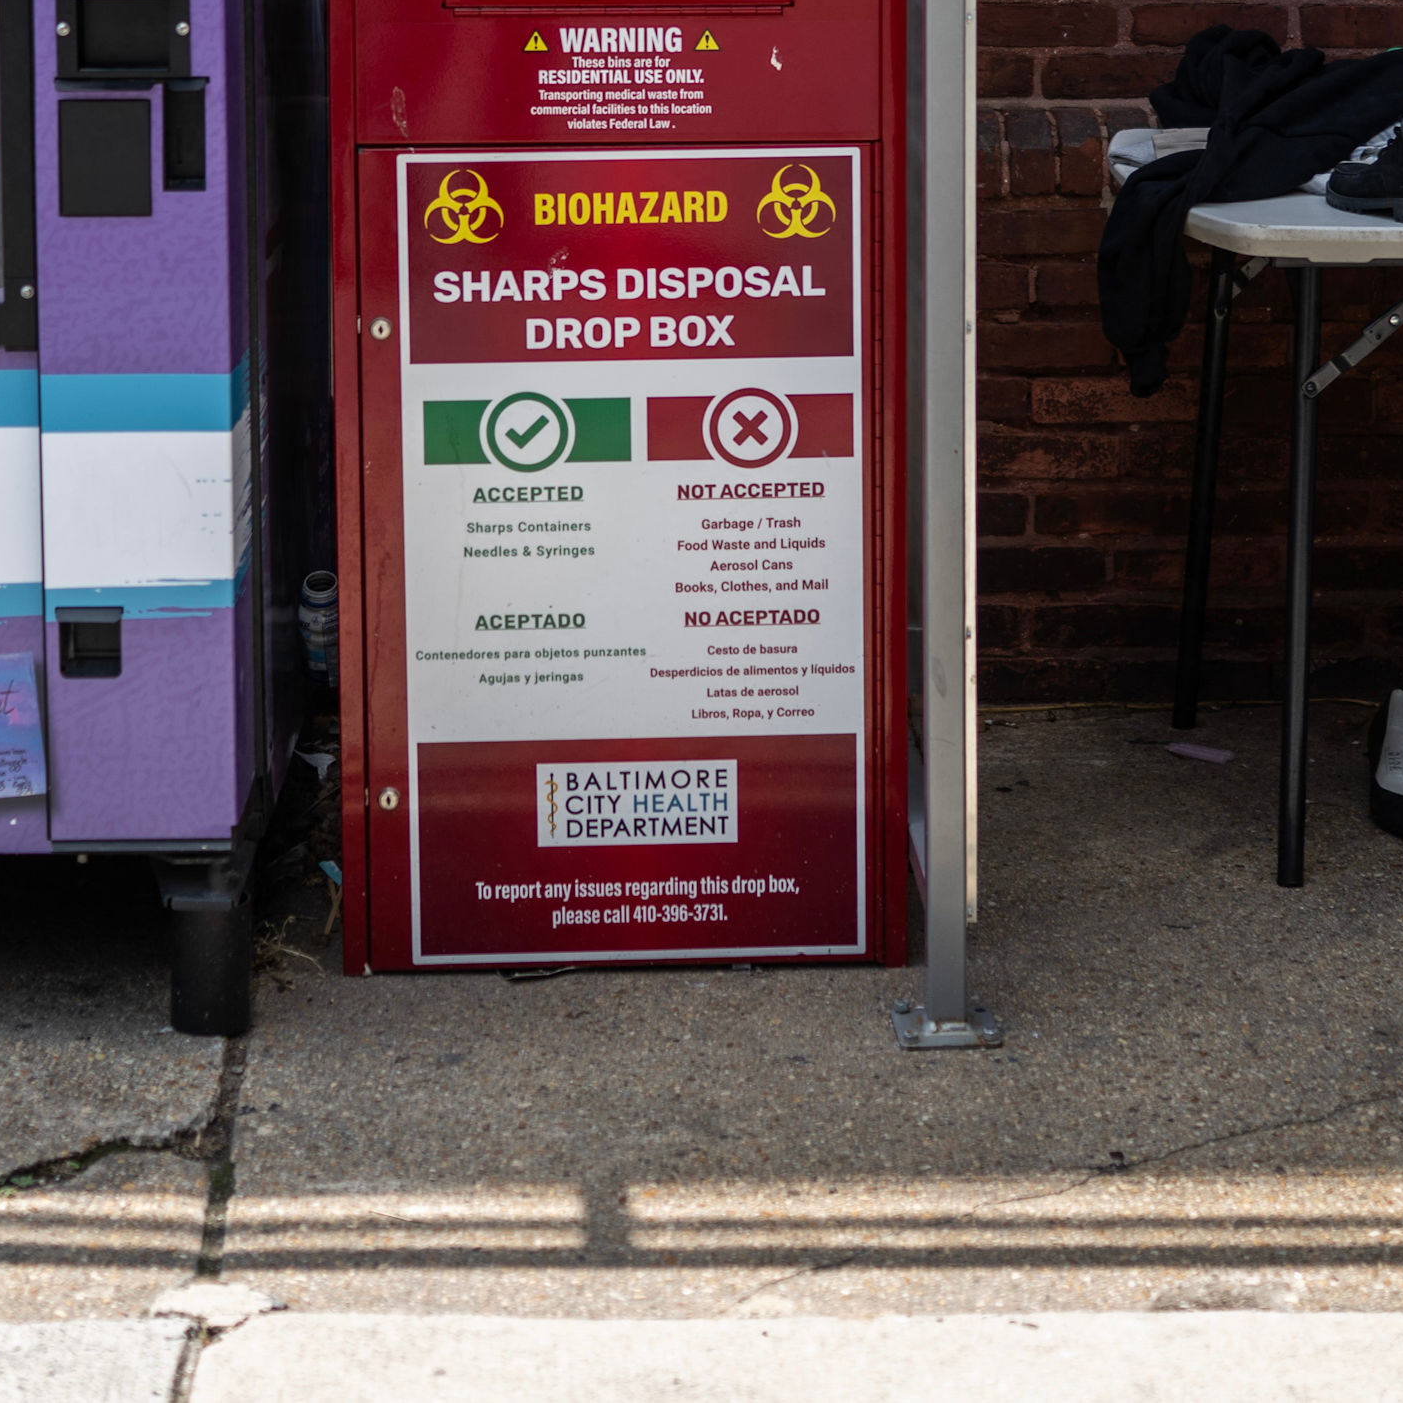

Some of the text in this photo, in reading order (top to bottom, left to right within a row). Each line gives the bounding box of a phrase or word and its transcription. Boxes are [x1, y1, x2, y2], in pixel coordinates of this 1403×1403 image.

[558, 26, 683, 53] WARNING
[571, 55, 671, 68] These bins are for
[537, 69, 705, 85] RESIDENTIAL USE ONLY.
[537, 88, 704, 103] Transporting medical waste from
[529, 102, 713, 116] commercial facilities to this location
[566, 117, 671, 130] violates Federal Law
[533, 190, 729, 226] BIOHAZARD
[433, 265, 826, 303] SHARPS DISPOSAL
[525, 314, 735, 350] DROP BOX
[472, 486, 583, 503] ACCEPTED
[677, 482, 825, 500] NOT ACCEPTED
[465, 520, 591, 535] Sharps Containers
[701, 516, 801, 532] Garbage Trash
[463, 544, 595, 559] Needles Syringes
[677, 536, 826, 552] Food Waste and Liquids
[709, 559, 793, 572] Aerosol Cans
[674, 578, 829, 594] Books, Clothes, and Mail
[475, 613, 586, 629] ACEPTADO
[684, 608, 820, 627] NO ACEPTADO
[415, 647, 647, 662] Contenedores para objetos punzantes
[706, 643, 798, 656] Cesto de basura
[478, 671, 584, 686] Agujas y jeringas
[649, 663, 856, 680] Desperdicios de alimentos y líquidos
[706, 685, 799, 698] Latas de aerosol
[691, 707, 815, 721] Libros, Ropa, y Correo
[565, 768, 728, 792] BALTIMORE
[564, 792, 728, 816] CITY HEALTH
[566, 815, 729, 839] DEPARTMENT
[474, 875, 800, 902] To report any issues regarding this drop box,
[551, 903, 728, 929] please call 410-396-3731.
